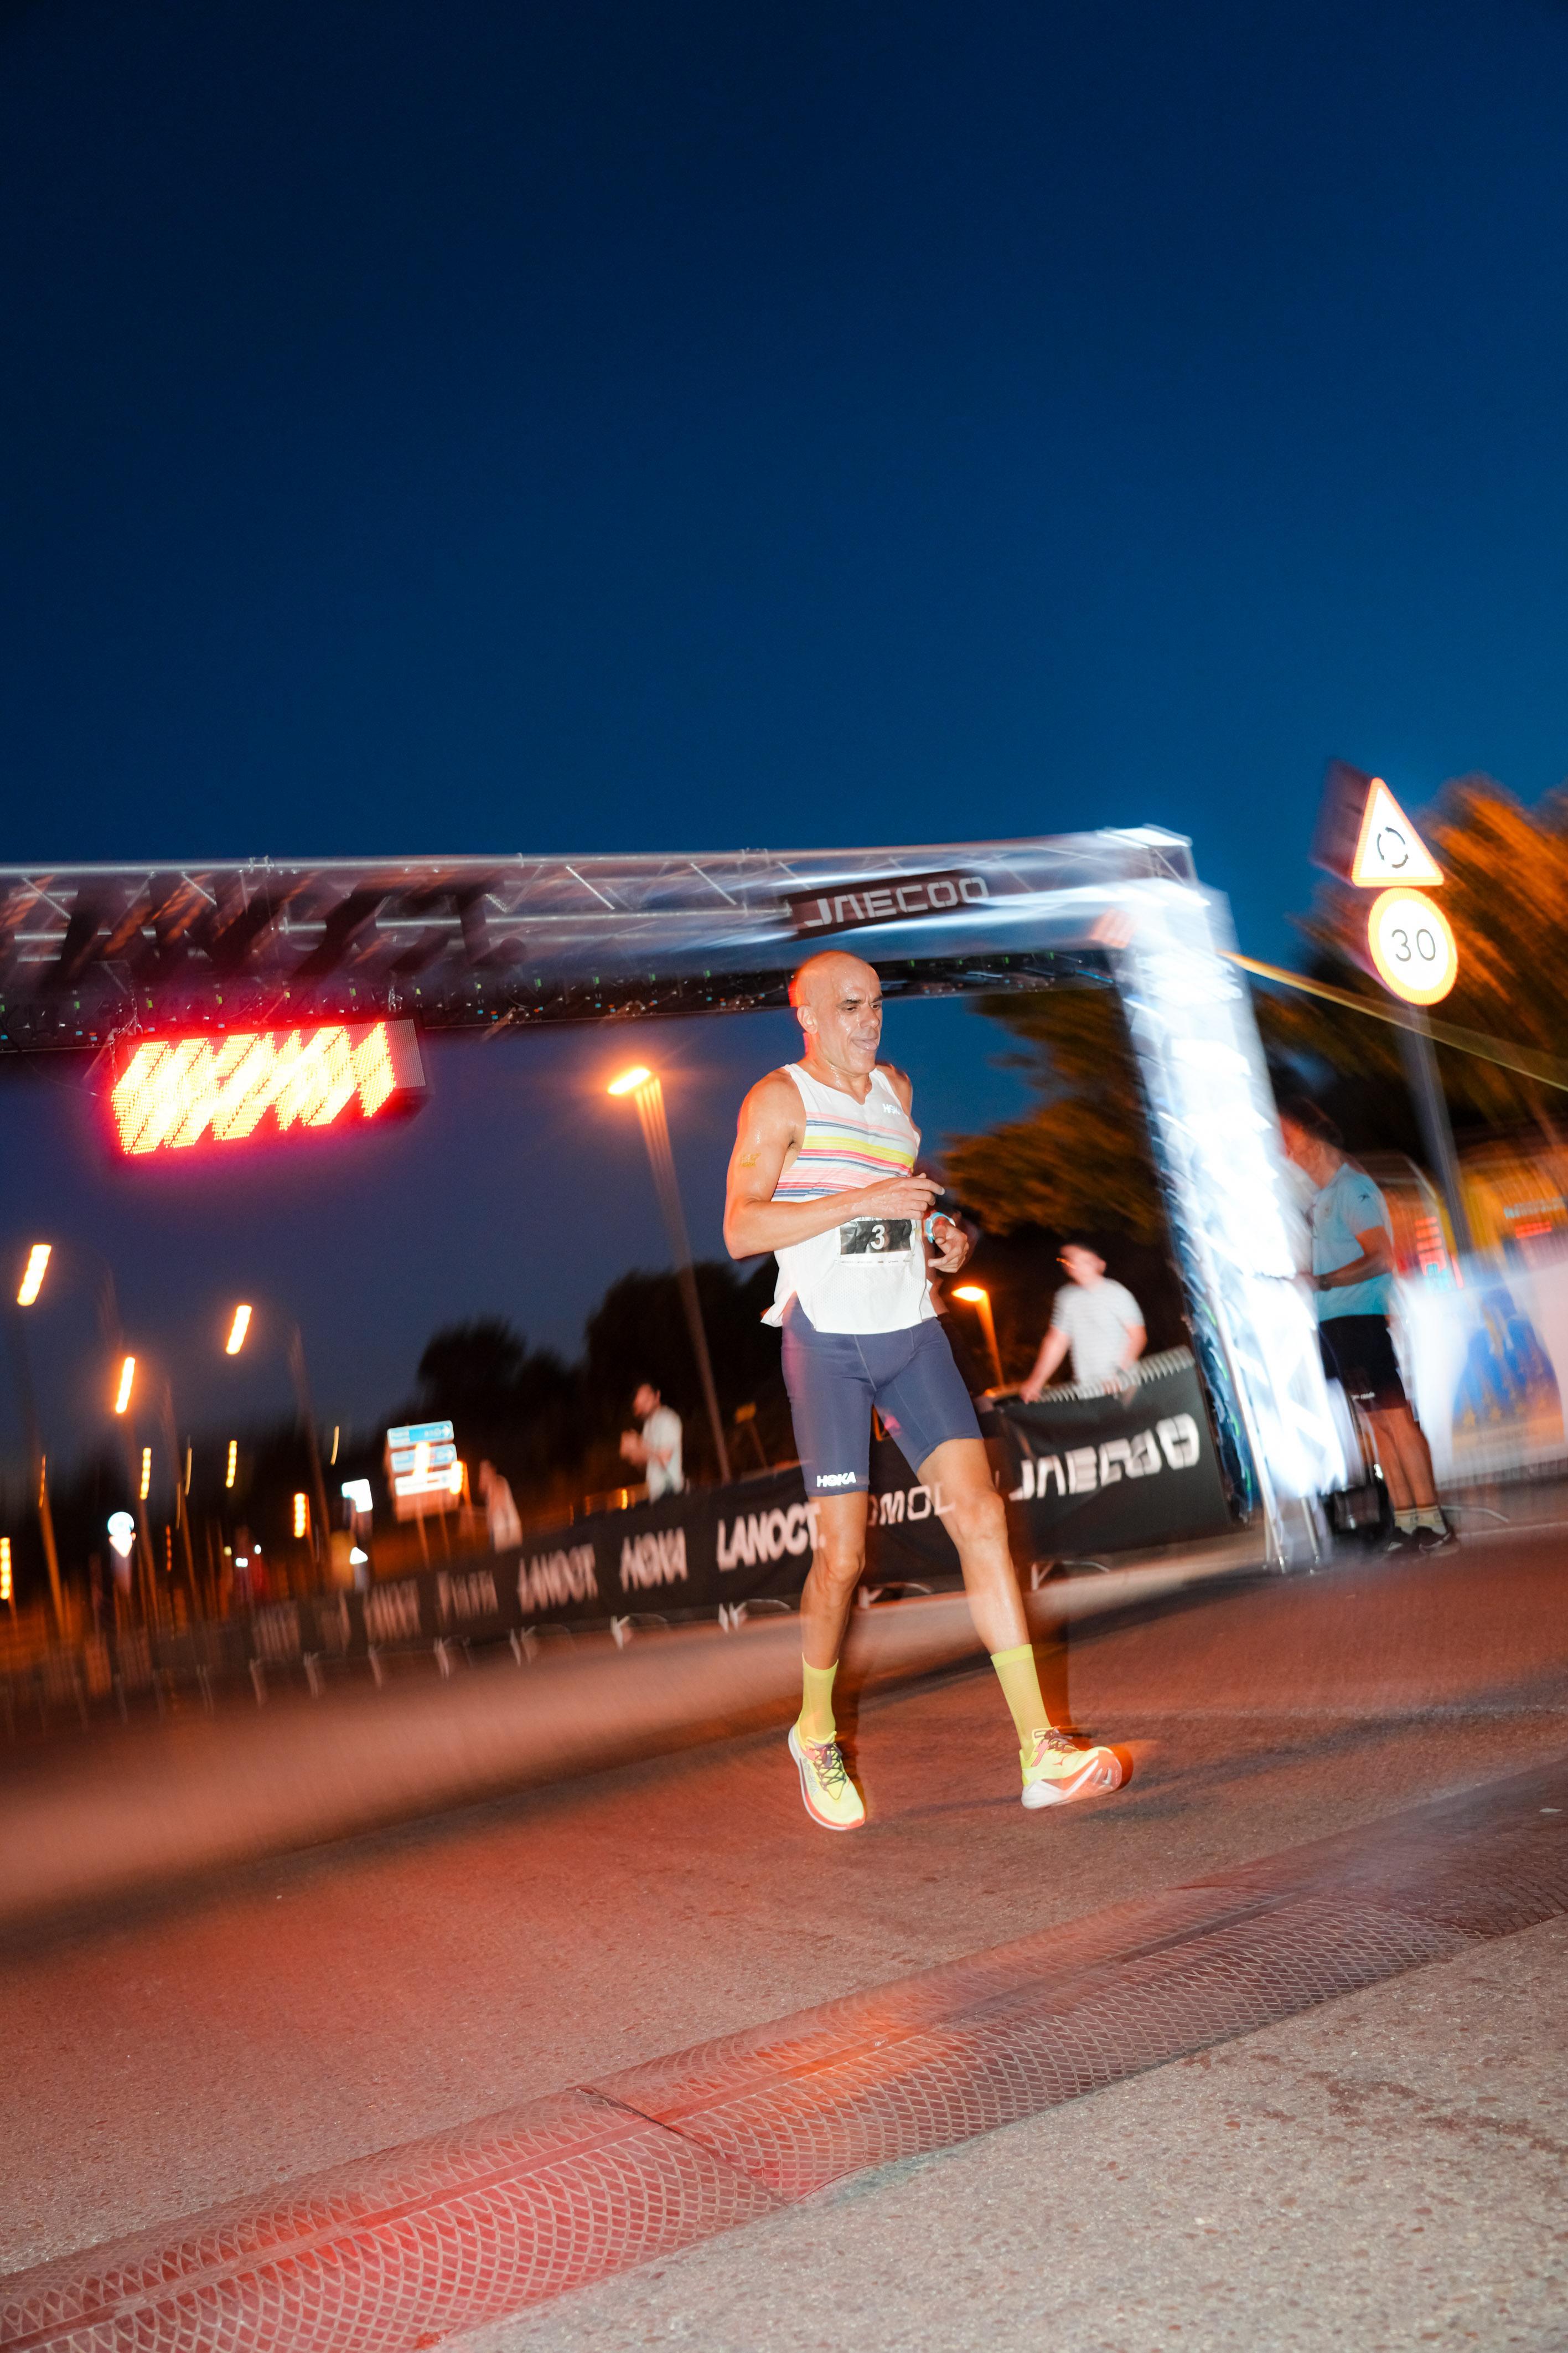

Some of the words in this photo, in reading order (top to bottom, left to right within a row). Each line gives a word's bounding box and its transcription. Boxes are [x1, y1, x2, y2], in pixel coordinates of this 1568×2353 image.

[804, 876, 989, 927] JAECOO
[1391, 928, 1436, 962] 30
[871, 1224, 886, 1250] 3
[816, 1472, 856, 1487] HOKA
